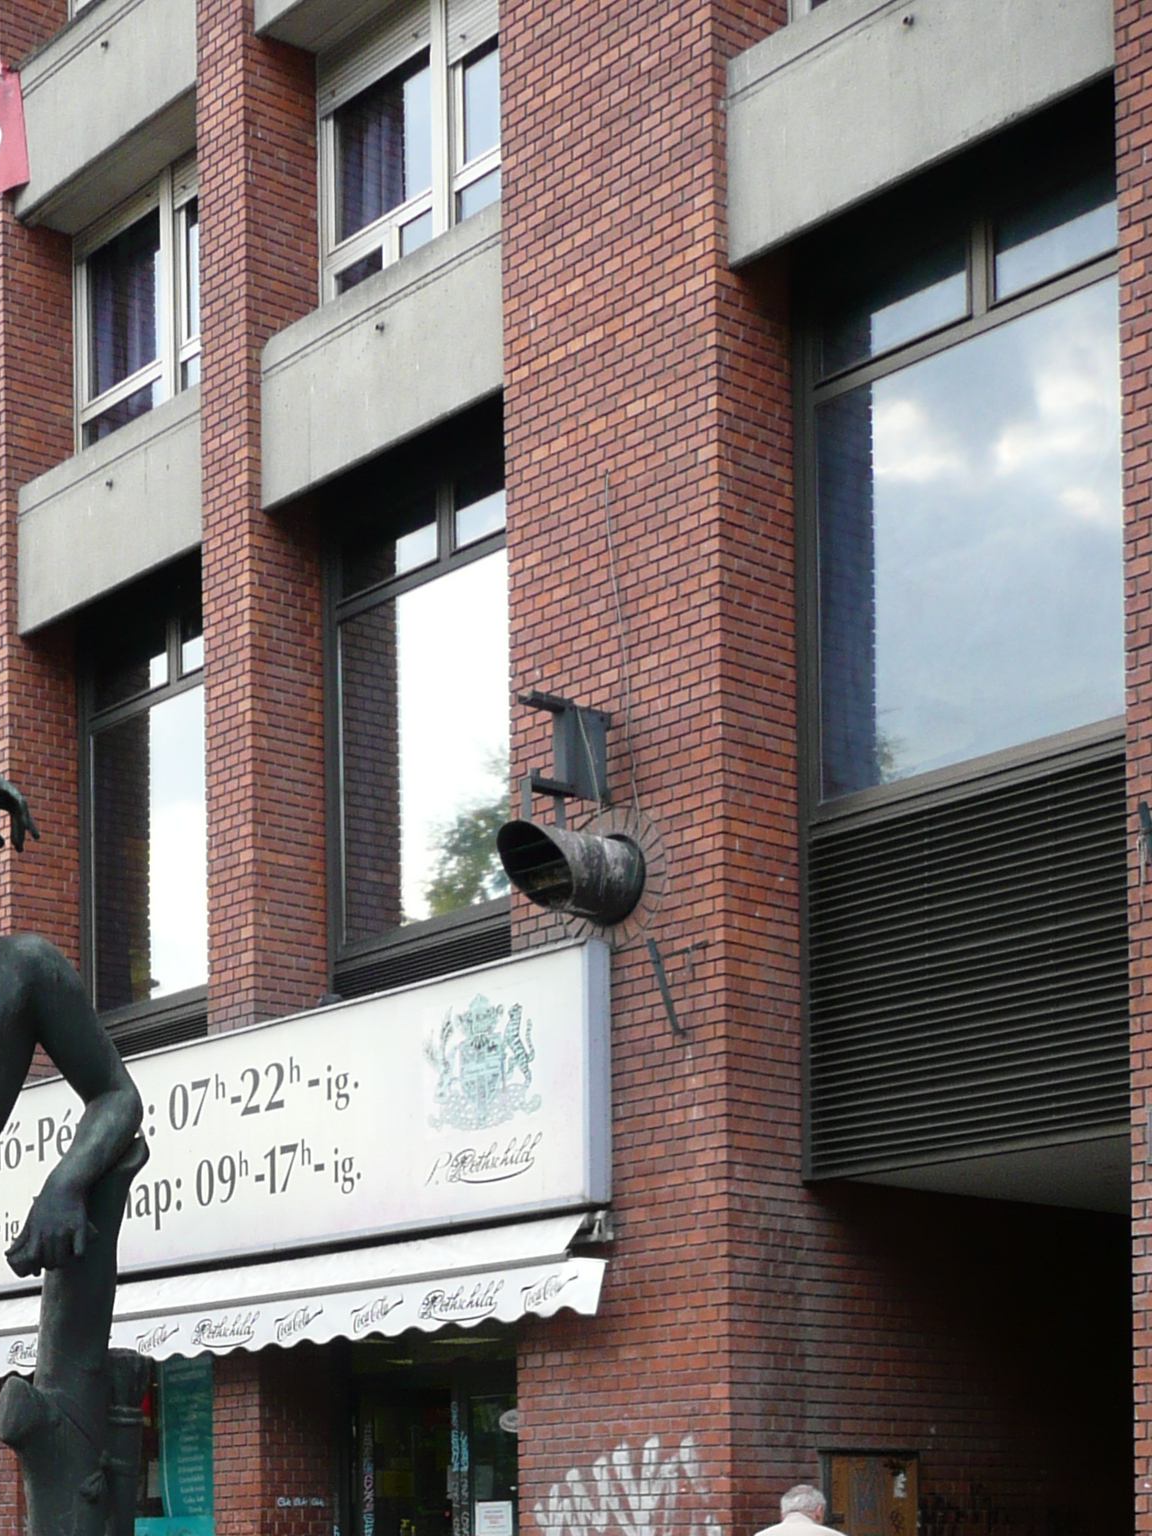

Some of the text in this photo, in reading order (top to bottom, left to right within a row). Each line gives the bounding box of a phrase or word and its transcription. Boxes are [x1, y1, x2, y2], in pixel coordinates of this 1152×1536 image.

[190, 1310, 262, 1348] Rothschild
[274, 1302, 324, 1342] Coca-Cola
[350, 1292, 405, 1334] Coca-Cola
[417, 1278, 505, 1321] Rothschild
